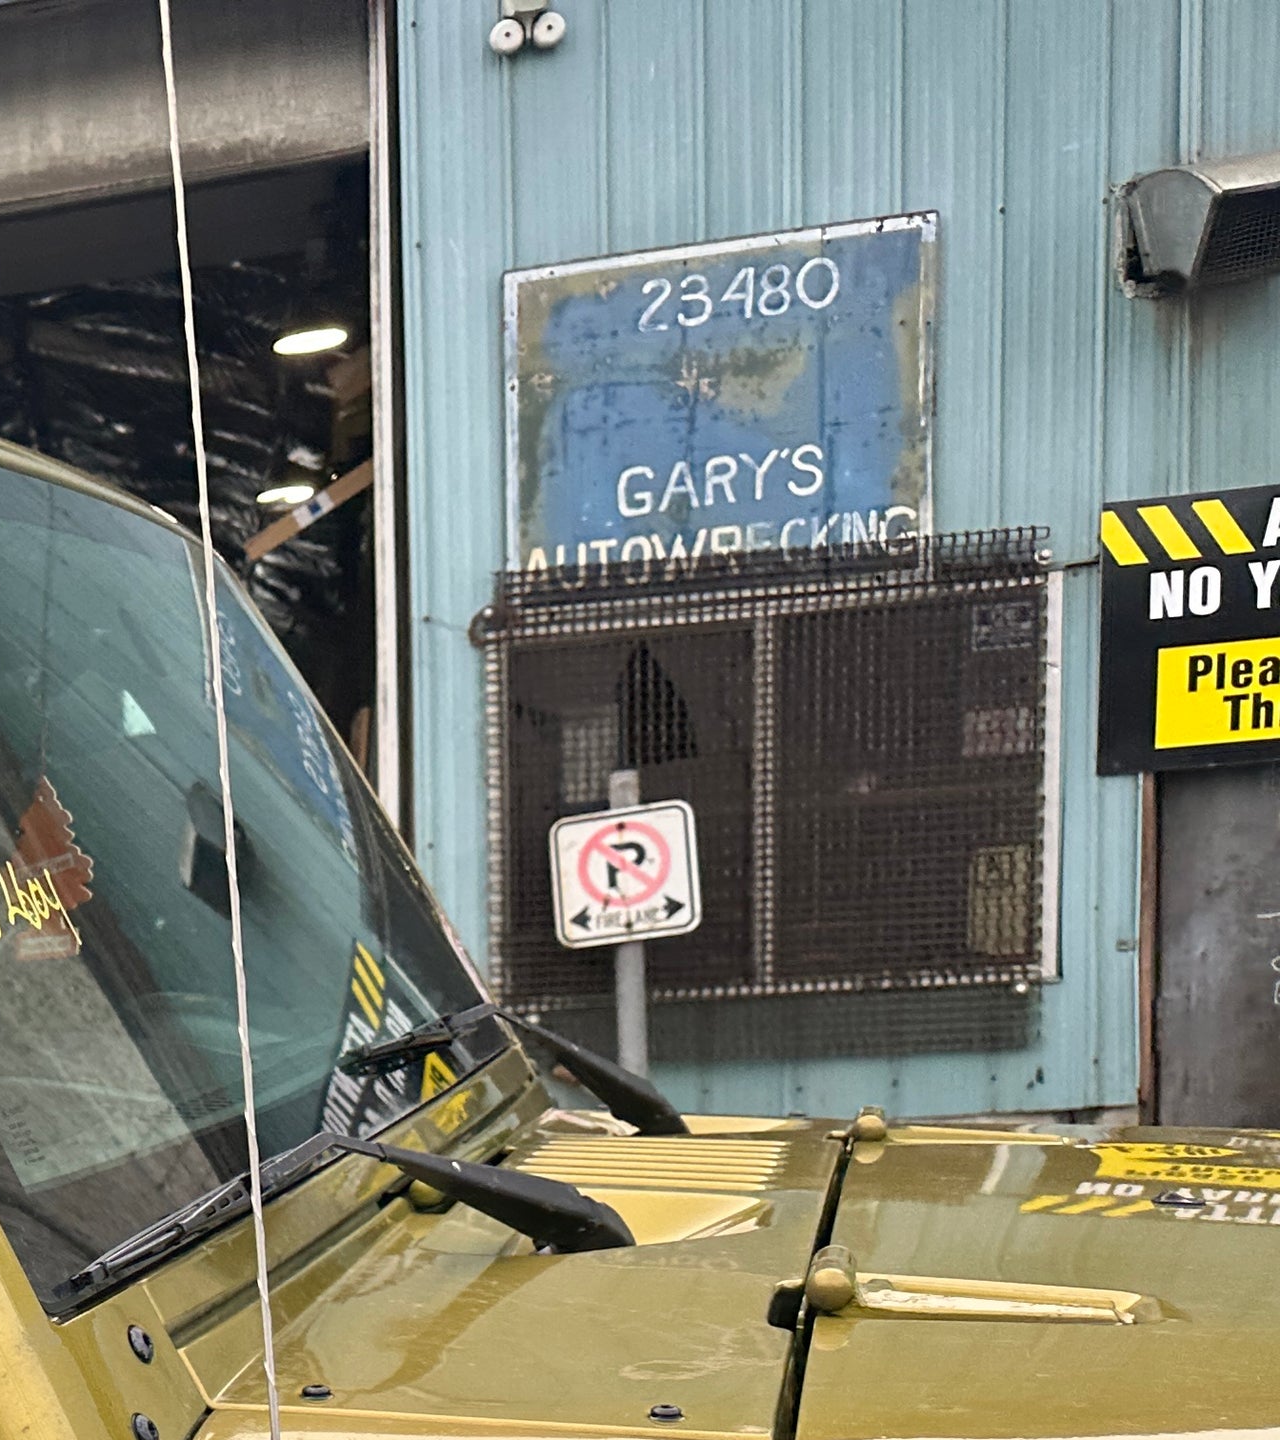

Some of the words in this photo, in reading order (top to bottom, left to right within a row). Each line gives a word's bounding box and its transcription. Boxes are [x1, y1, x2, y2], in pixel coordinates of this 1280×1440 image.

[638, 257, 840, 332] 23480
[617, 444, 824, 517] GARY'S
[1149, 565, 1222, 620] NO
[1223, 691, 1280, 731] Th
